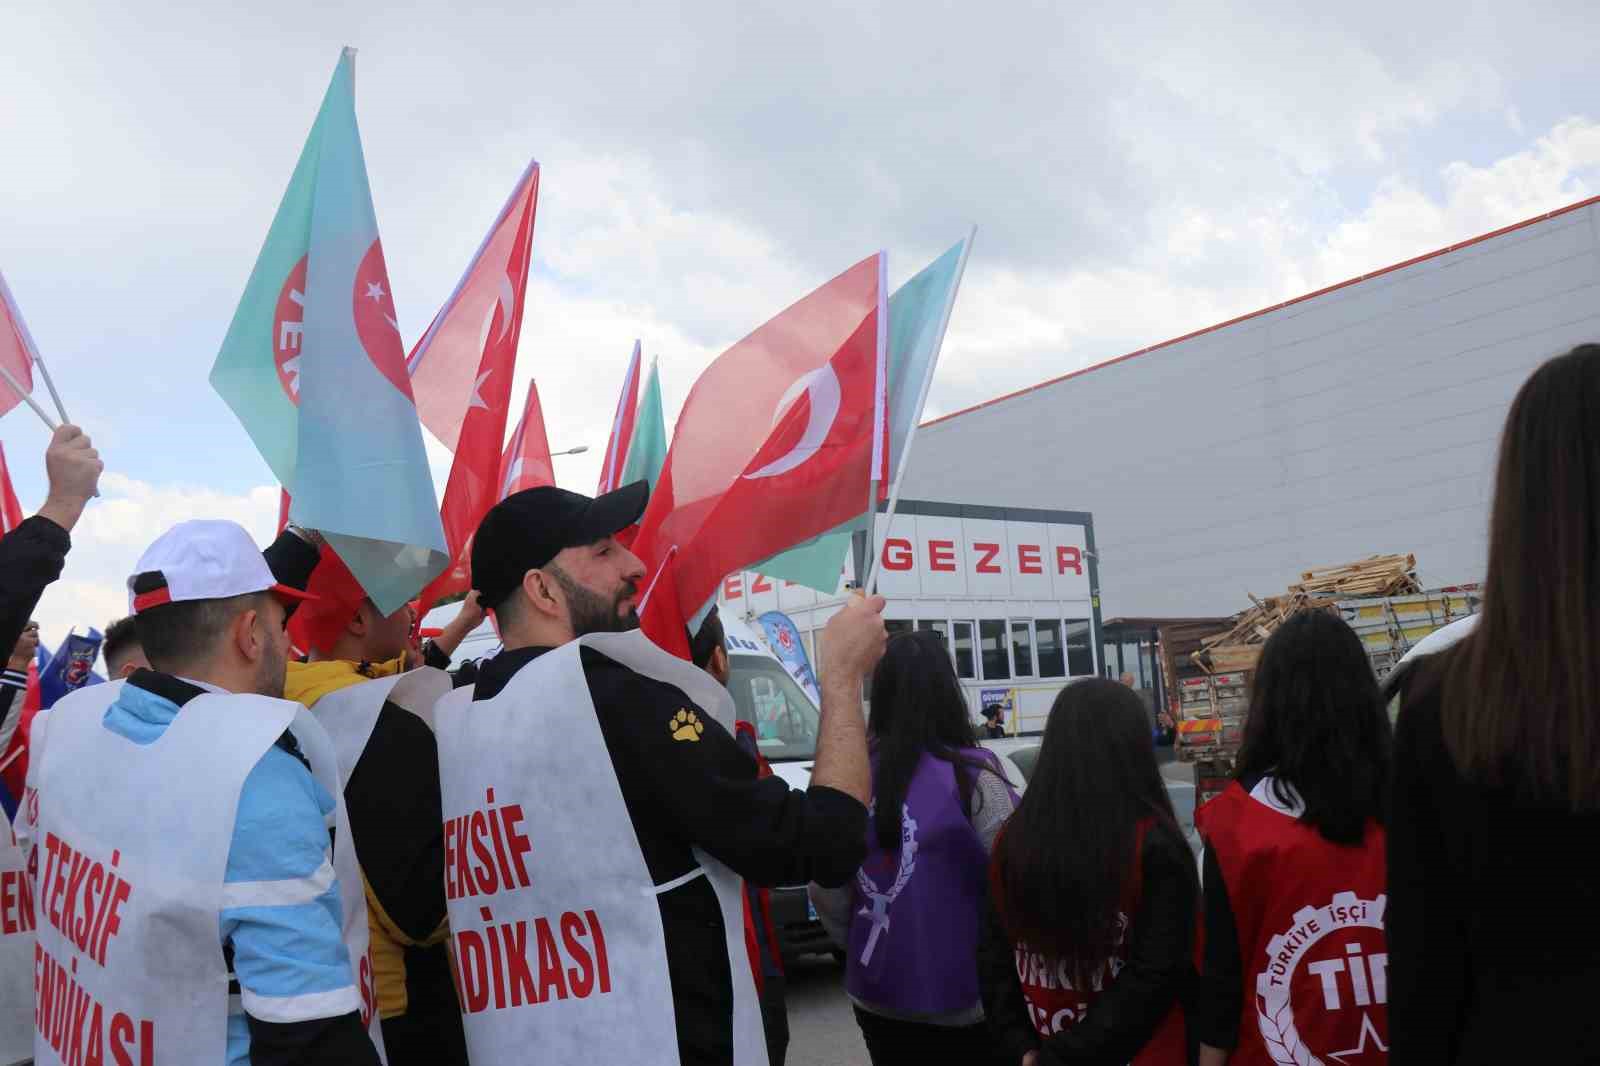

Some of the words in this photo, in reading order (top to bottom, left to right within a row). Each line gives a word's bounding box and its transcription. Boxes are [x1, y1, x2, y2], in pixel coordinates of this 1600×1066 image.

[882, 538, 1082, 575] GEZER
[443, 787, 532, 900] EKSİF
[42, 832, 131, 968] TEKSİF
[1270, 919, 1320, 986] TÜRKİYE
[1328, 902, 1366, 923] İŞÇİ
